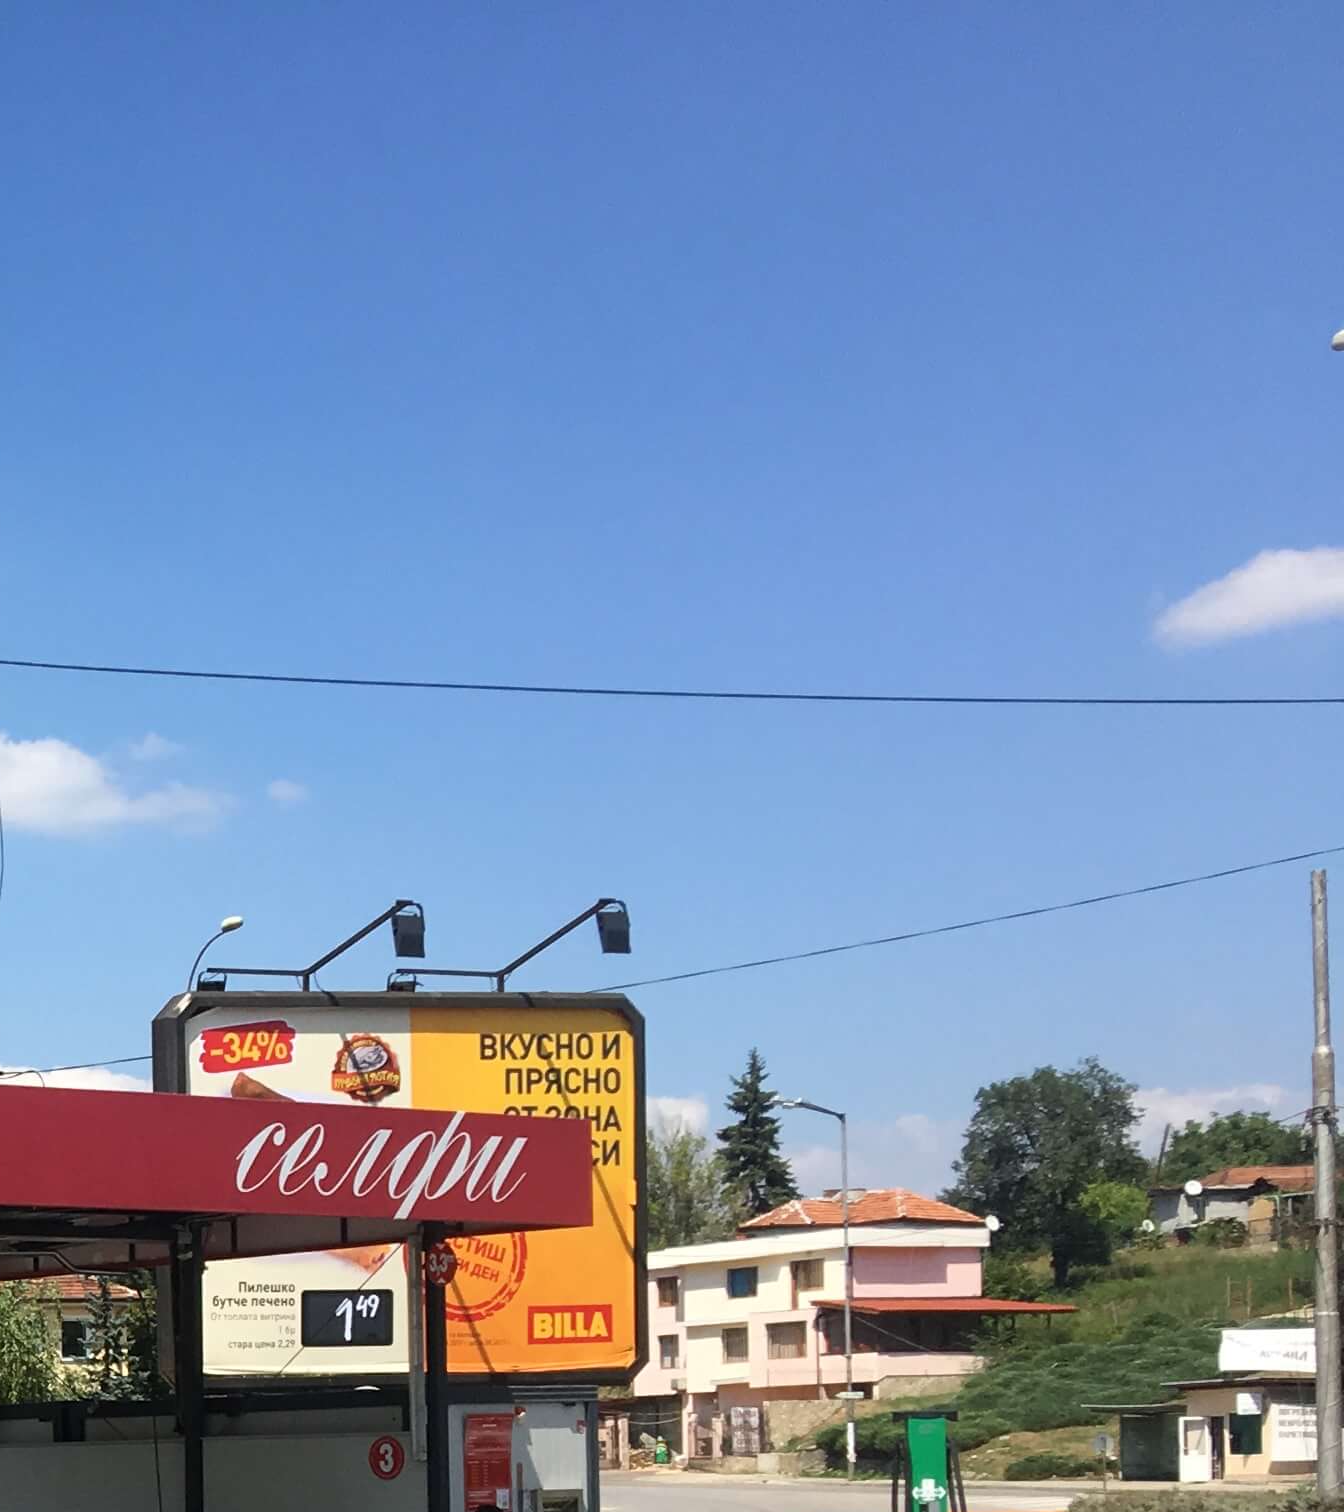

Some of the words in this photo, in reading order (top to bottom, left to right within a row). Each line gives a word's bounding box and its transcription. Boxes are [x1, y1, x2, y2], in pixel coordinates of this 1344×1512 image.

[210, 1030, 289, 1064] -34%
[480, 1033, 593, 1060] ВКУСНО
[602, 1033, 620, 1060] И
[505, 1067, 621, 1094] ПРЯСНО
[236, 1111, 528, 1219] селфи
[470, 1263, 500, 1282] ДЕН
[238, 1281, 296, 1294] Пилешко
[212, 1295, 248, 1309] бутче
[251, 1296, 296, 1308] печено
[533, 1311, 609, 1339] BILLA
[379, 1443, 394, 1473] 3
